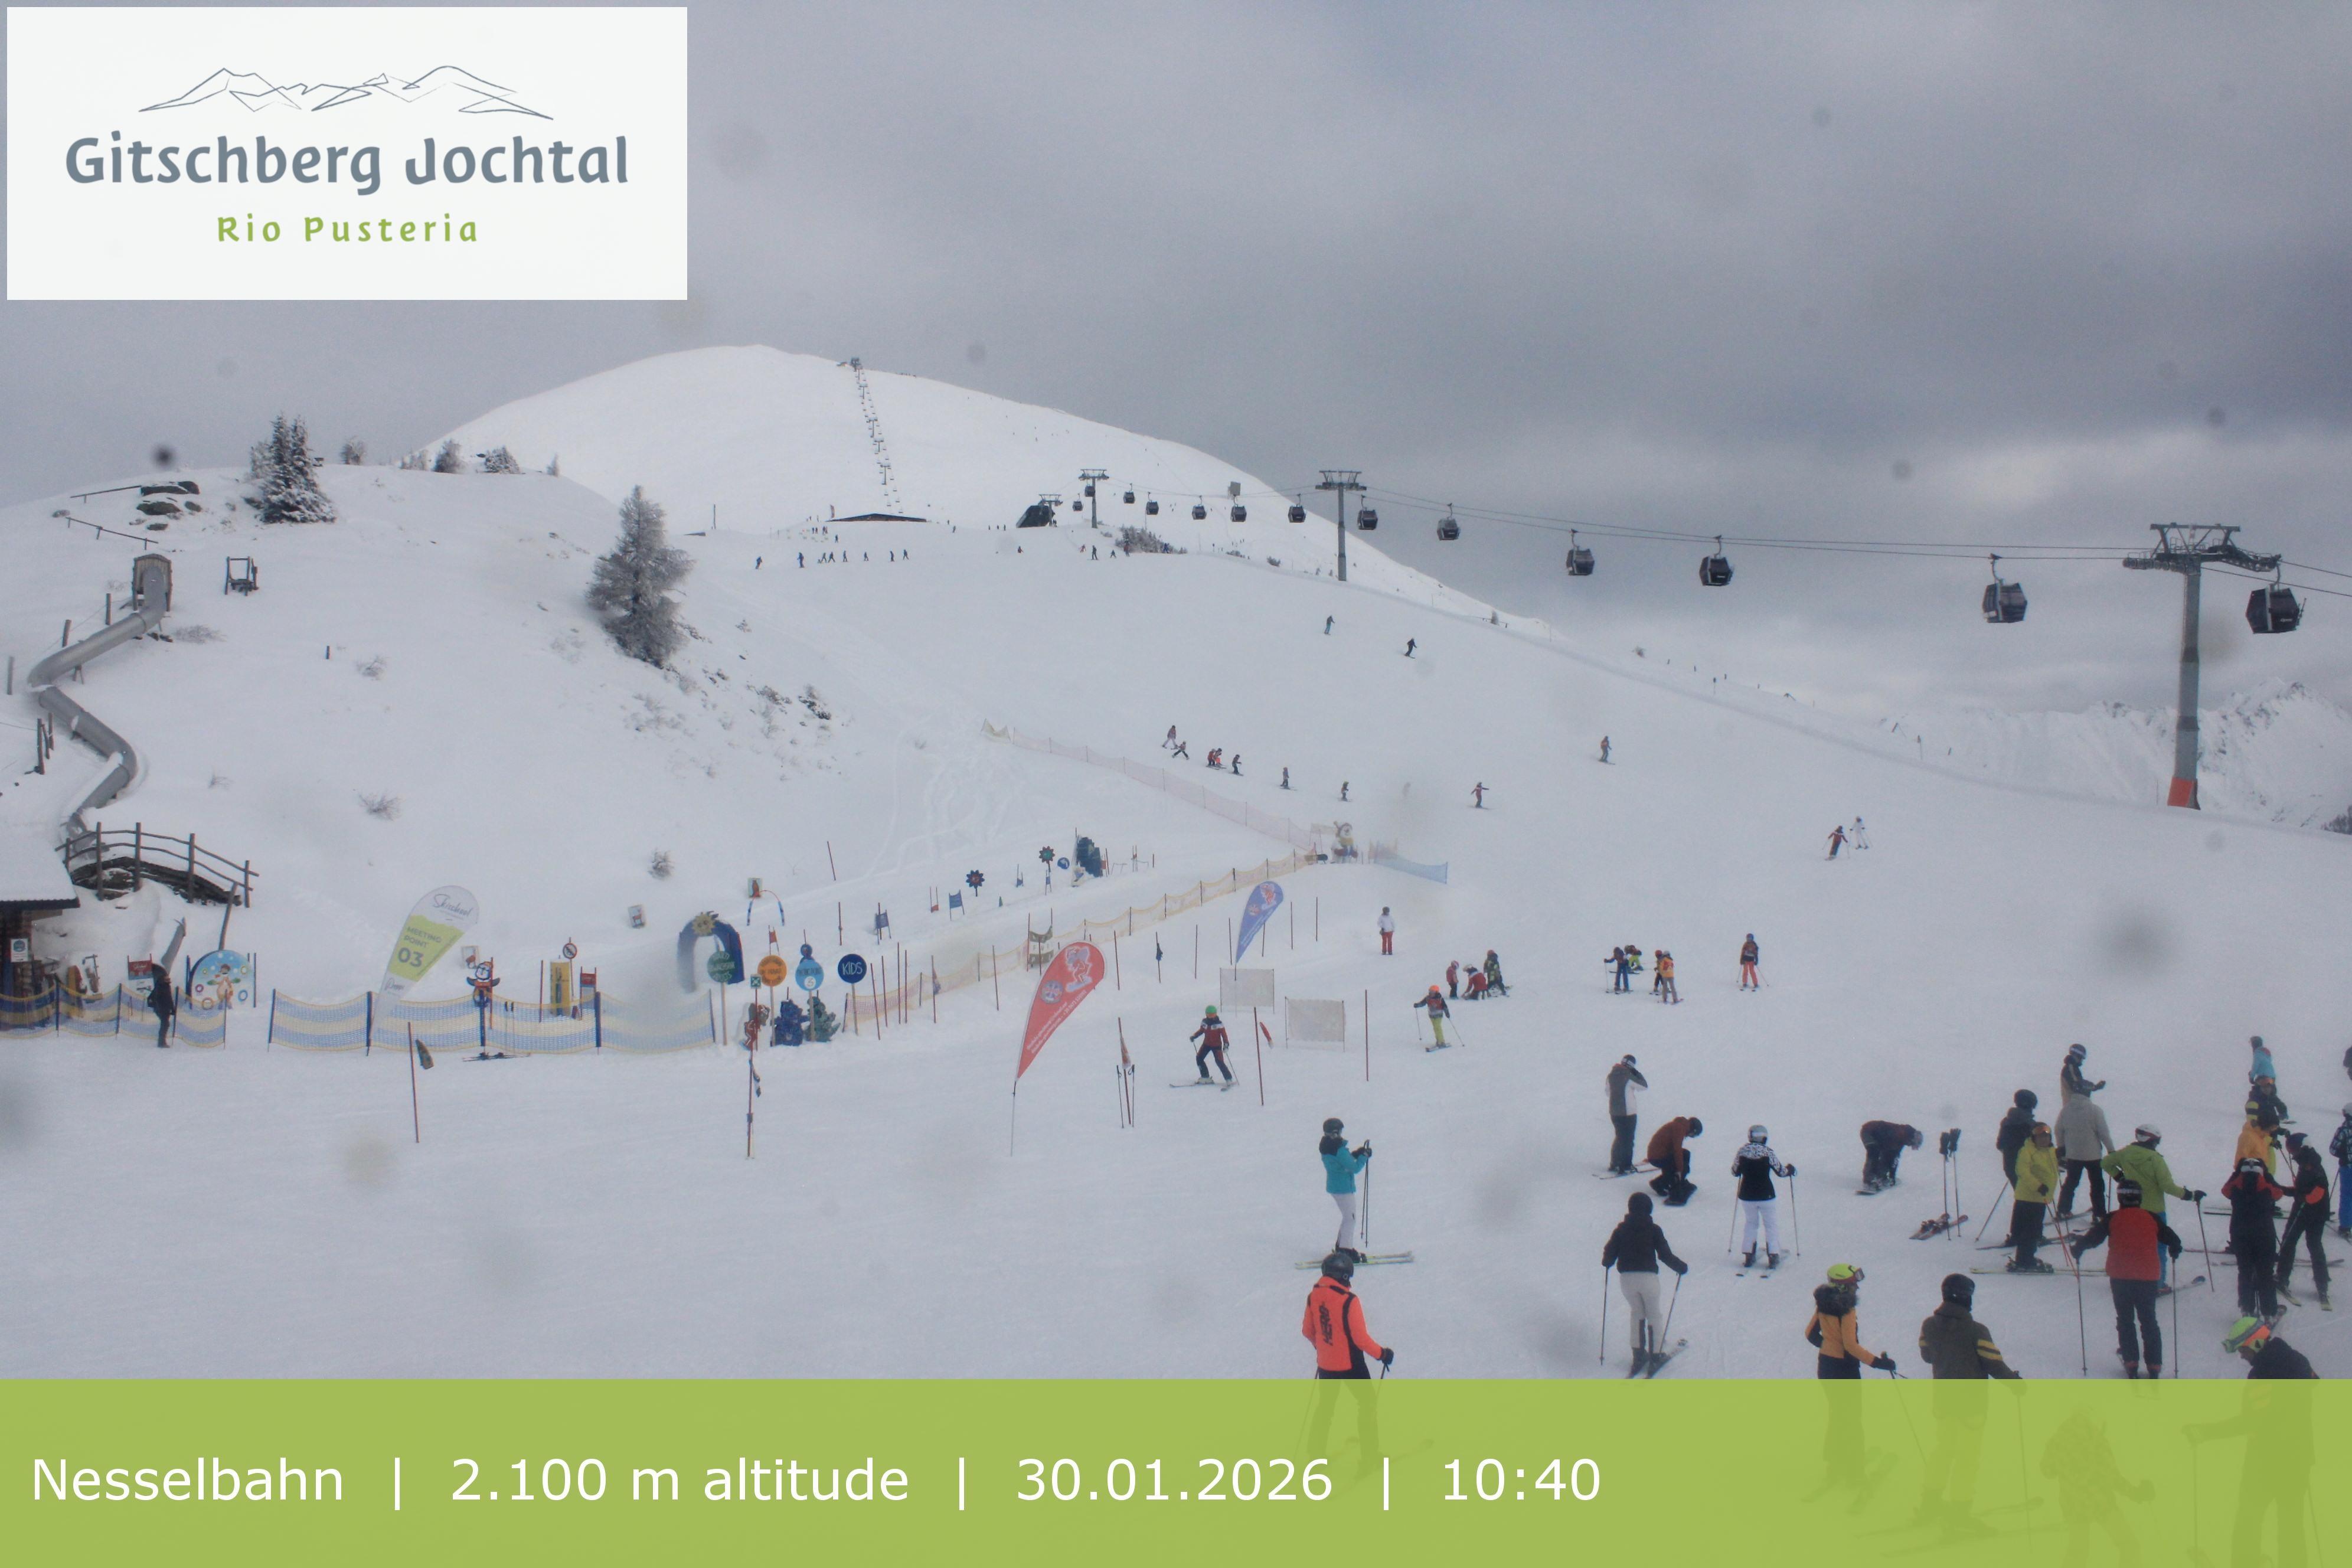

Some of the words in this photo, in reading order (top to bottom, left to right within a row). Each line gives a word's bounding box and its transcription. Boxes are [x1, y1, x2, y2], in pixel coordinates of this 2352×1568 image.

[404, 935, 429, 948] POINT
[406, 926, 442, 943] MEETING
[398, 947, 424, 967] 03
[842, 962, 863, 975] KIDS
